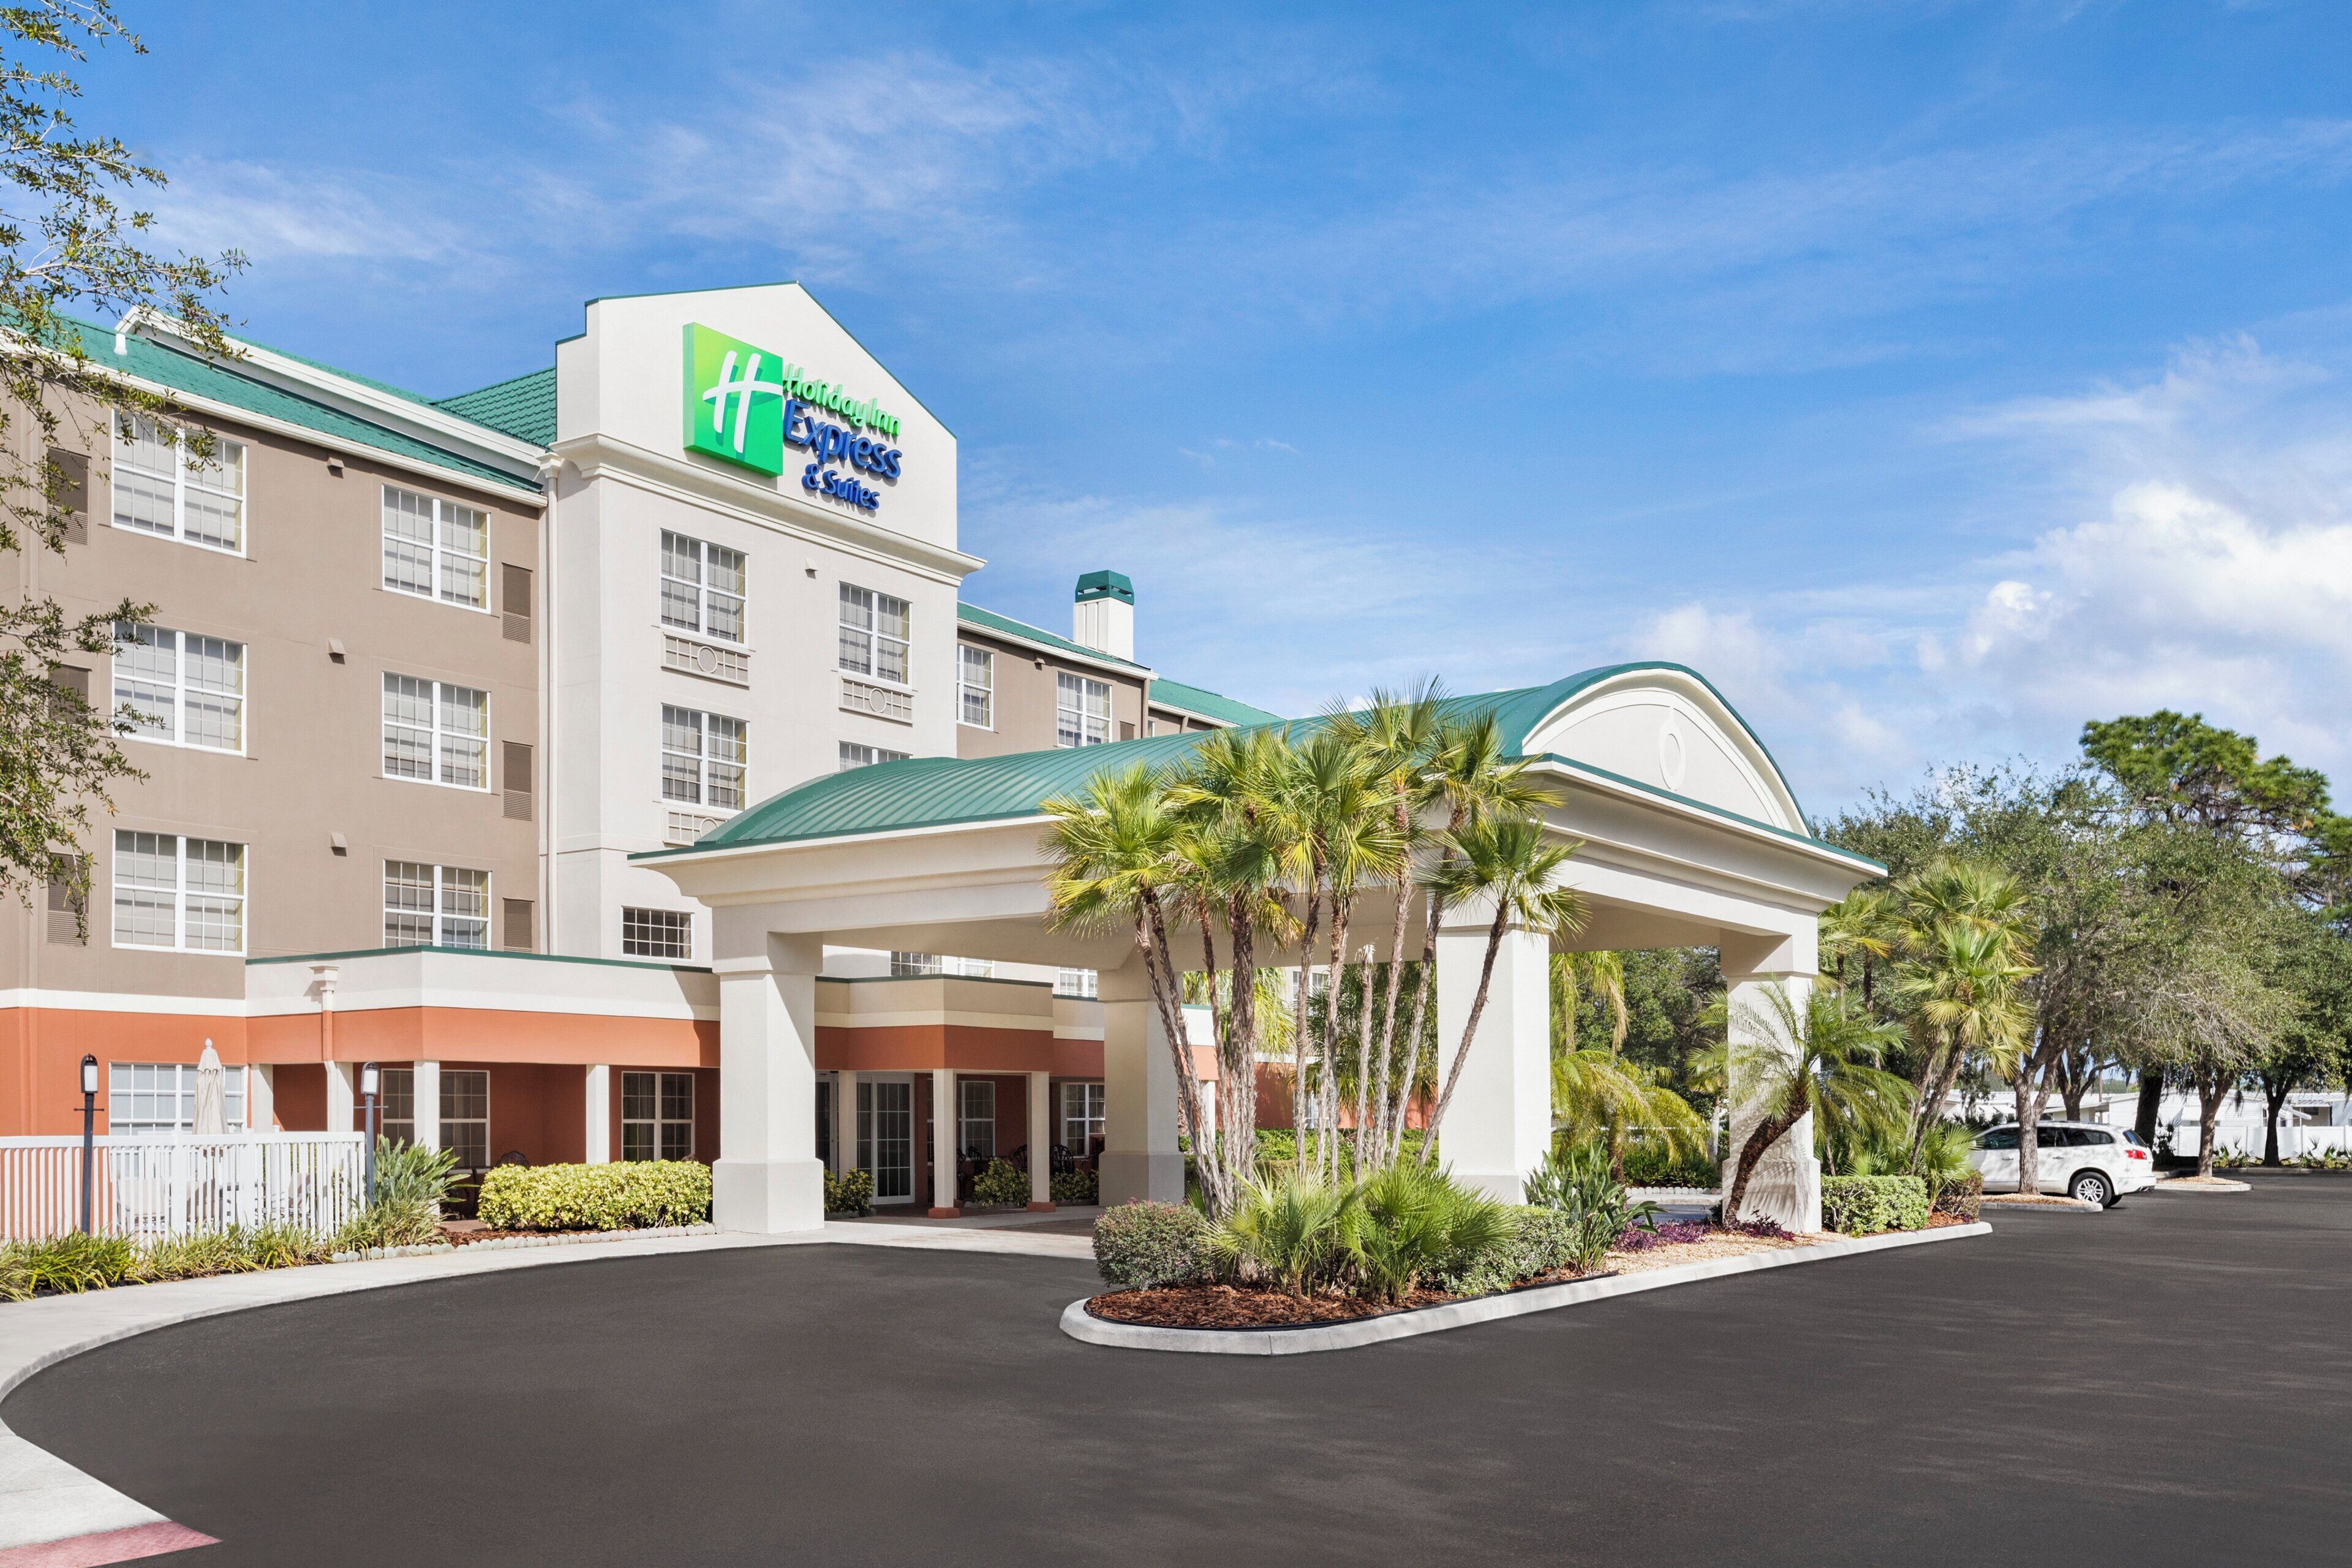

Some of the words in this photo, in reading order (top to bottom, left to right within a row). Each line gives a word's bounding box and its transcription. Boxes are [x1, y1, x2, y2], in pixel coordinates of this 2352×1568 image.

[783, 363, 867, 428] Holiday
[866, 398, 902, 436] Inn
[783, 399, 903, 479] Express
[801, 463, 821, 490] &
[819, 470, 880, 510] Suites
